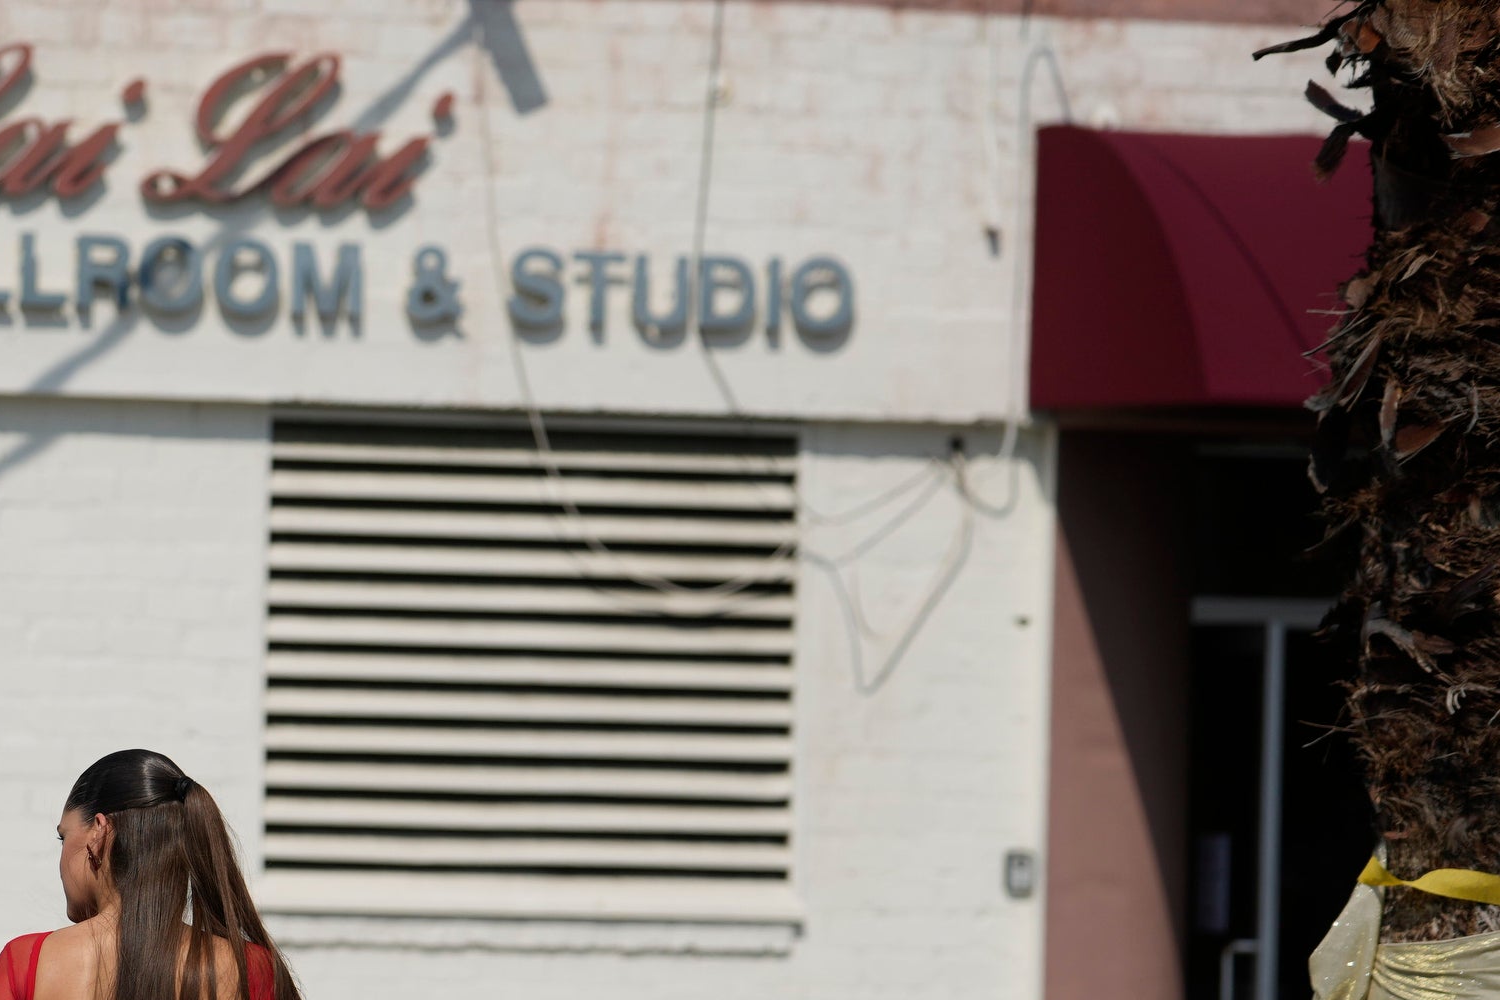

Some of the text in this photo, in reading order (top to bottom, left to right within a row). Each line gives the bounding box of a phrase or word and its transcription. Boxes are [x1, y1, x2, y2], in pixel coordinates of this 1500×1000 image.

[140, 50, 455, 210] Lai
[406, 244, 465, 330] &
[506, 246, 856, 341] STUDIO
